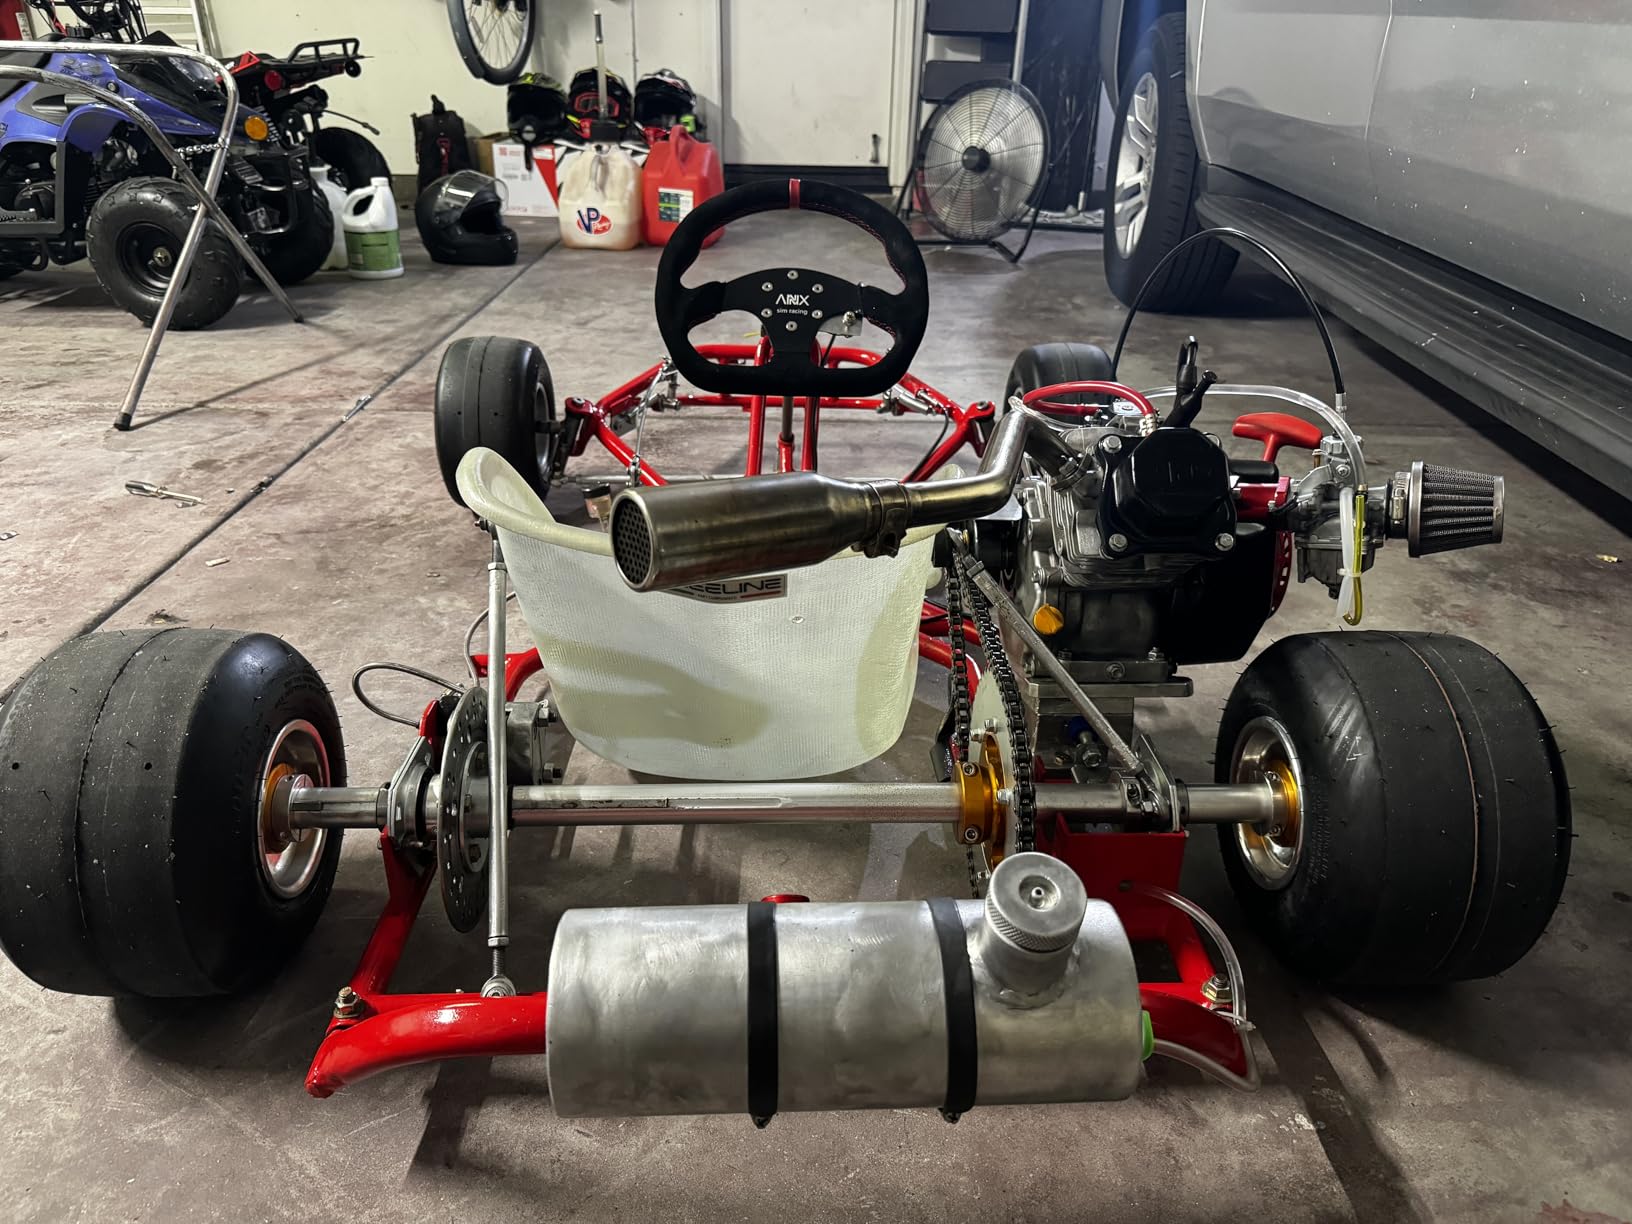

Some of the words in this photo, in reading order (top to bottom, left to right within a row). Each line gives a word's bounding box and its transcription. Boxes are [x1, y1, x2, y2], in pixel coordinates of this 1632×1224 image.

[577, 207, 600, 234] VP
[788, 308, 808, 316] racing
[686, 577, 782, 595] EELINE
